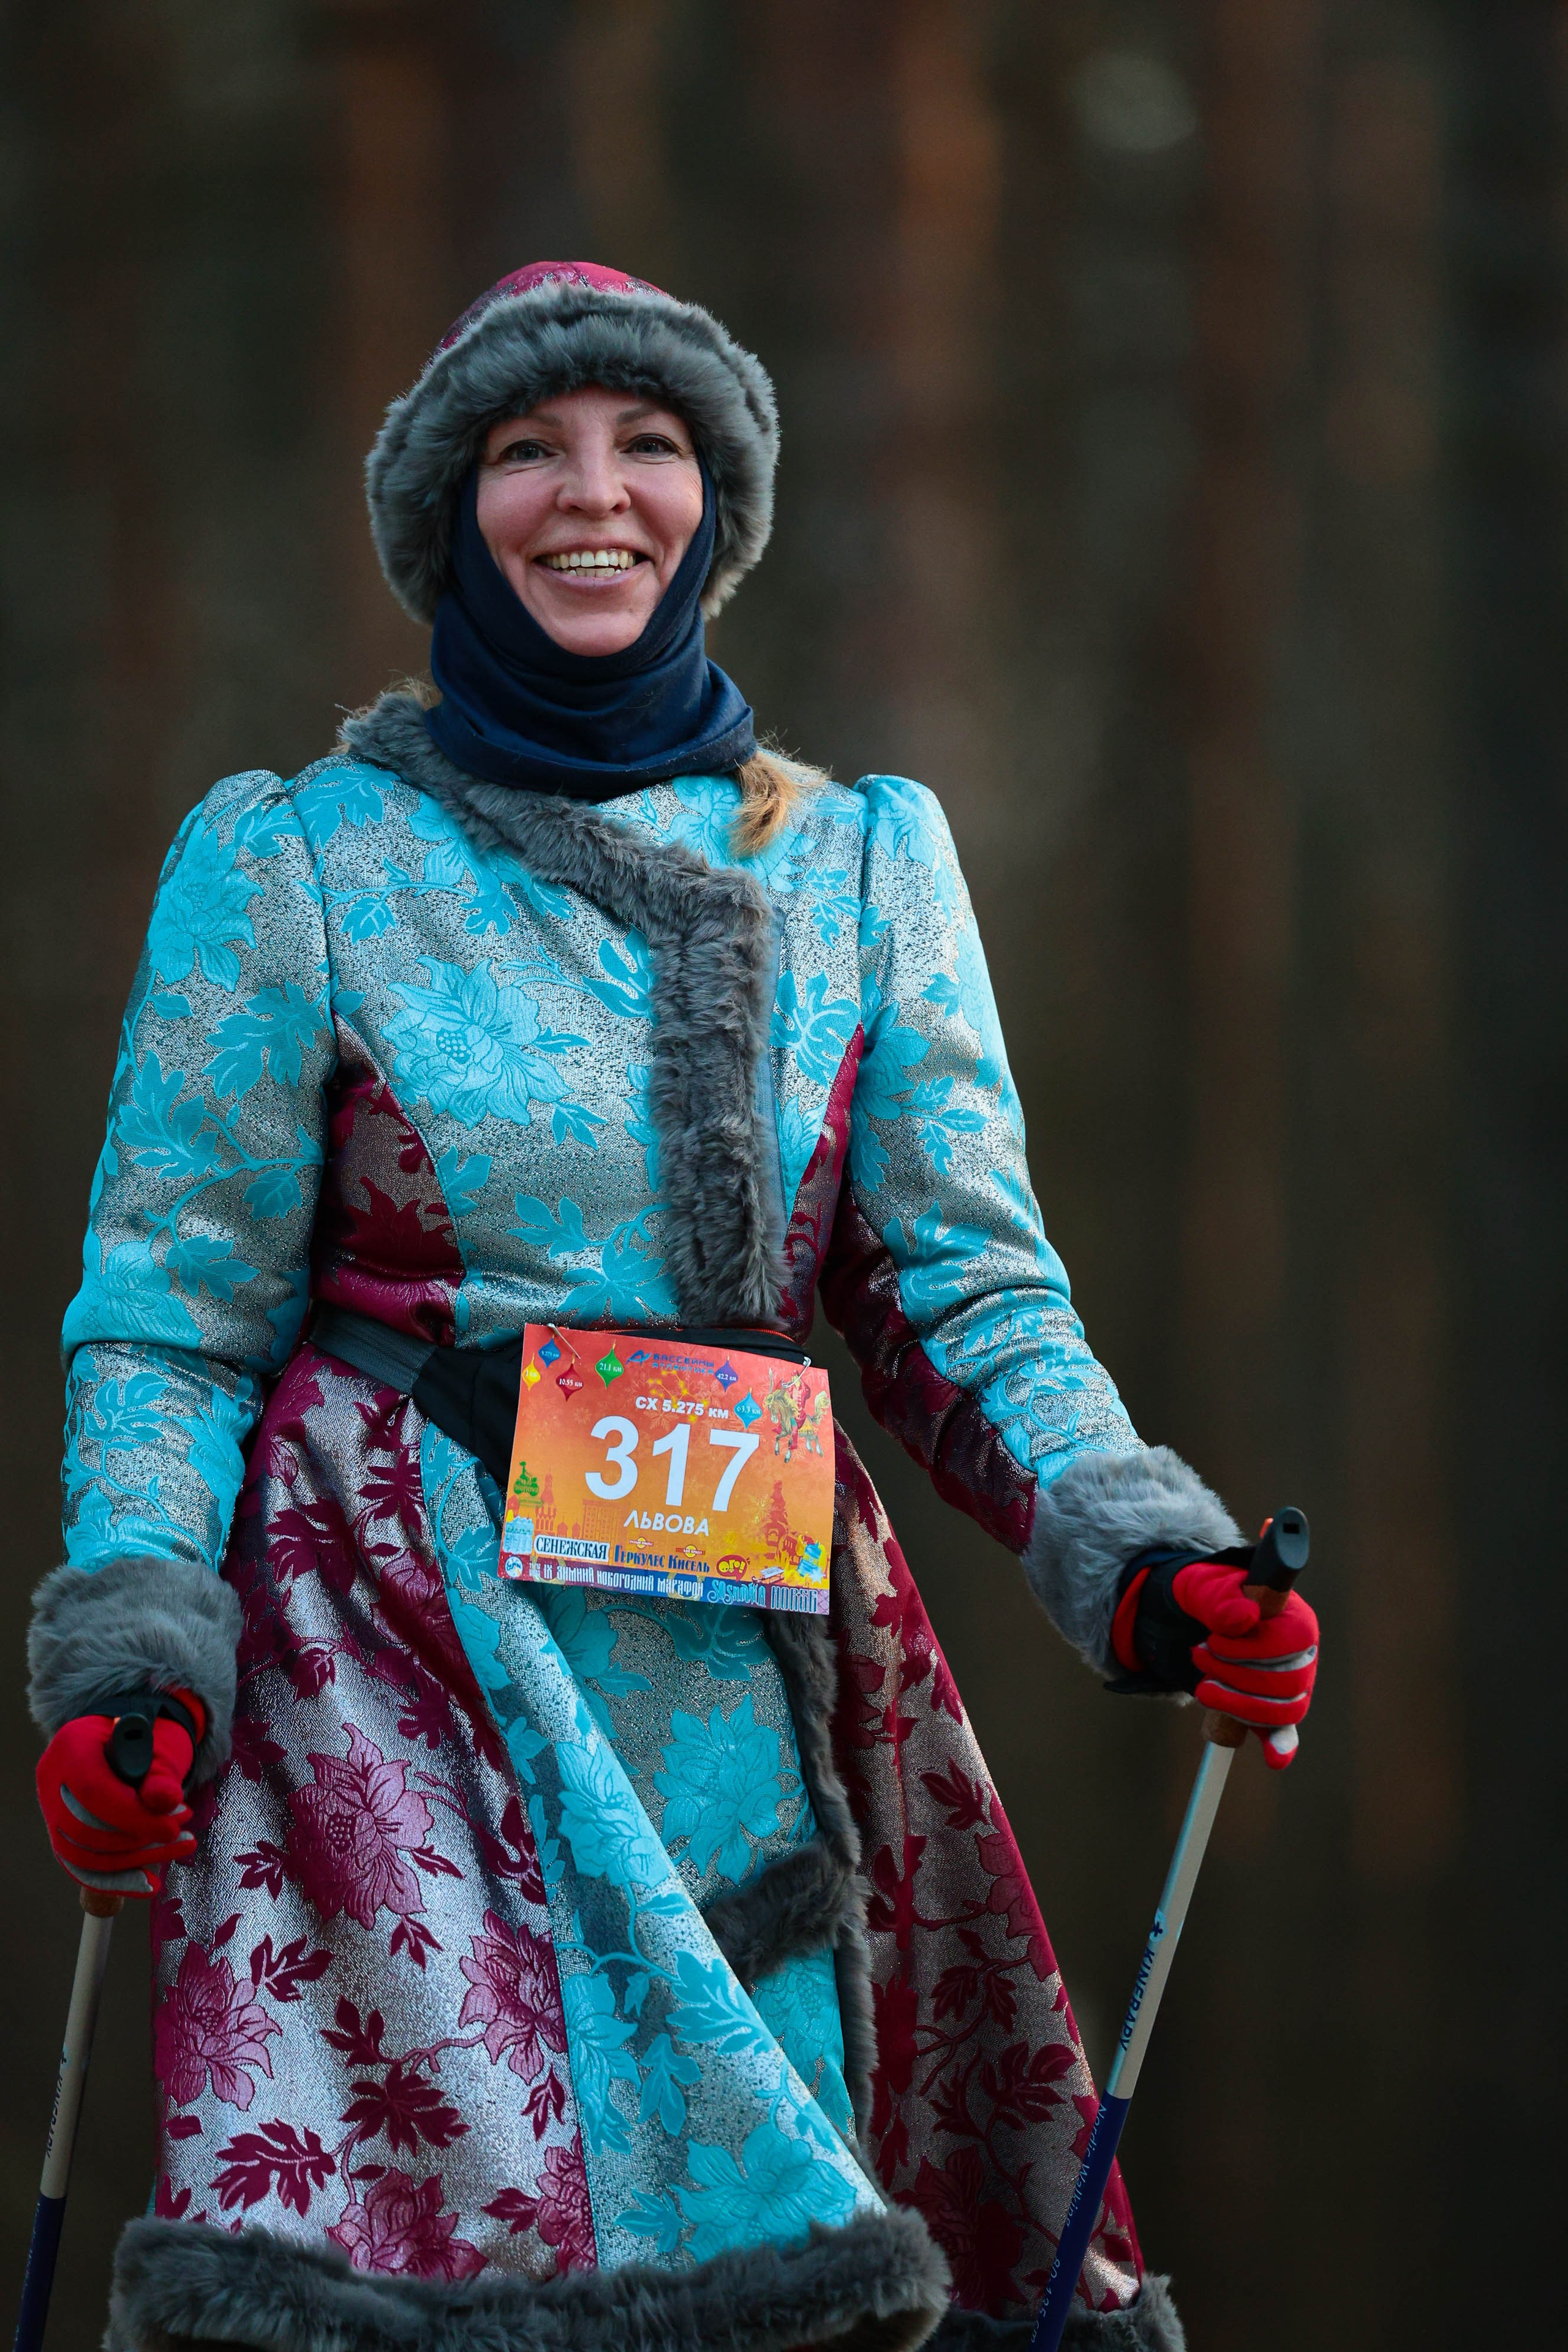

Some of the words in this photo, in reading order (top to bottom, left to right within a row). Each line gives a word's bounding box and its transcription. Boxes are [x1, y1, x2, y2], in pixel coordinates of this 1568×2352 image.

[599, 1362, 611, 1371] 21.1
[662, 1399, 704, 1416] 5.275
[585, 1415, 760, 1512] 317
[624, 1509, 709, 1537] ЛЬВОВА
[536, 1536, 608, 1560] СЕНЕЖСКАЯ
